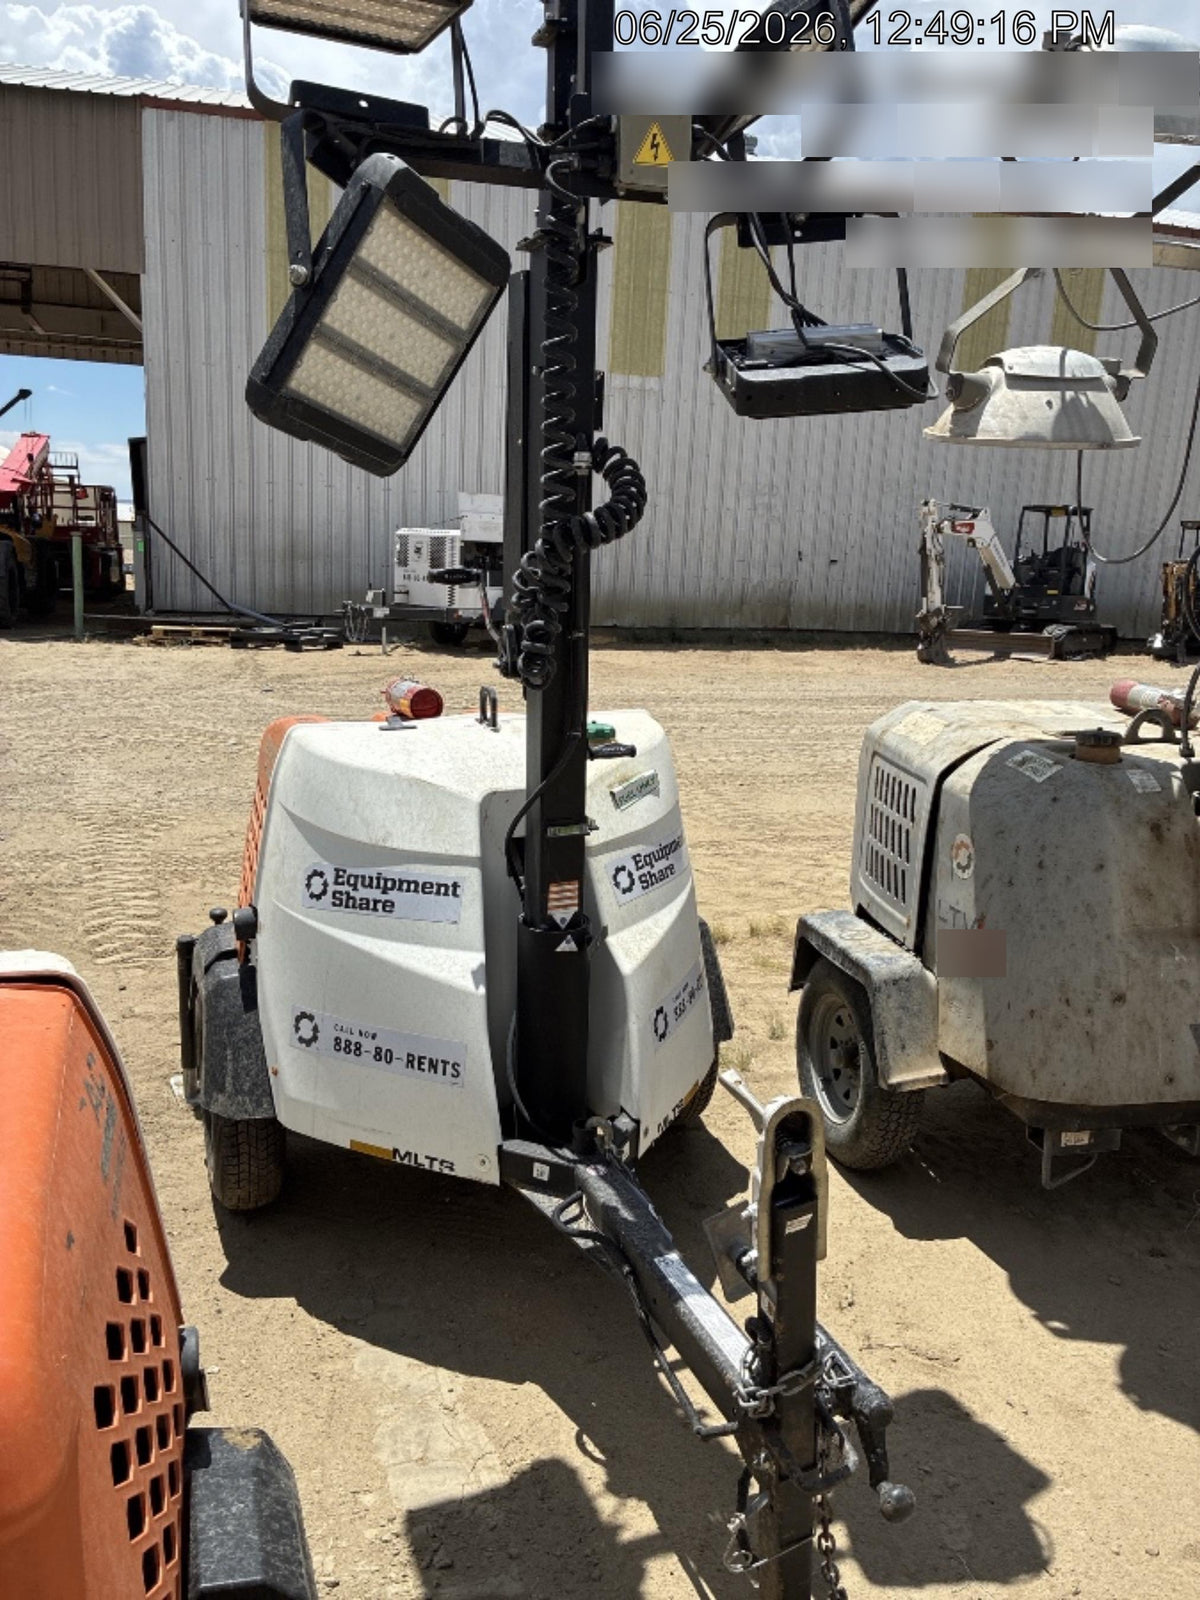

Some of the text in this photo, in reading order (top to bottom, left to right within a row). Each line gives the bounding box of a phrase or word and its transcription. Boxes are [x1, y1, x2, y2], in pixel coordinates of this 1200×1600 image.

[333, 867, 461, 898] Equipment
[638, 863, 677, 890] Share
[331, 889, 395, 913] Share
[333, 1036, 461, 1079] 888-80-RENTS
